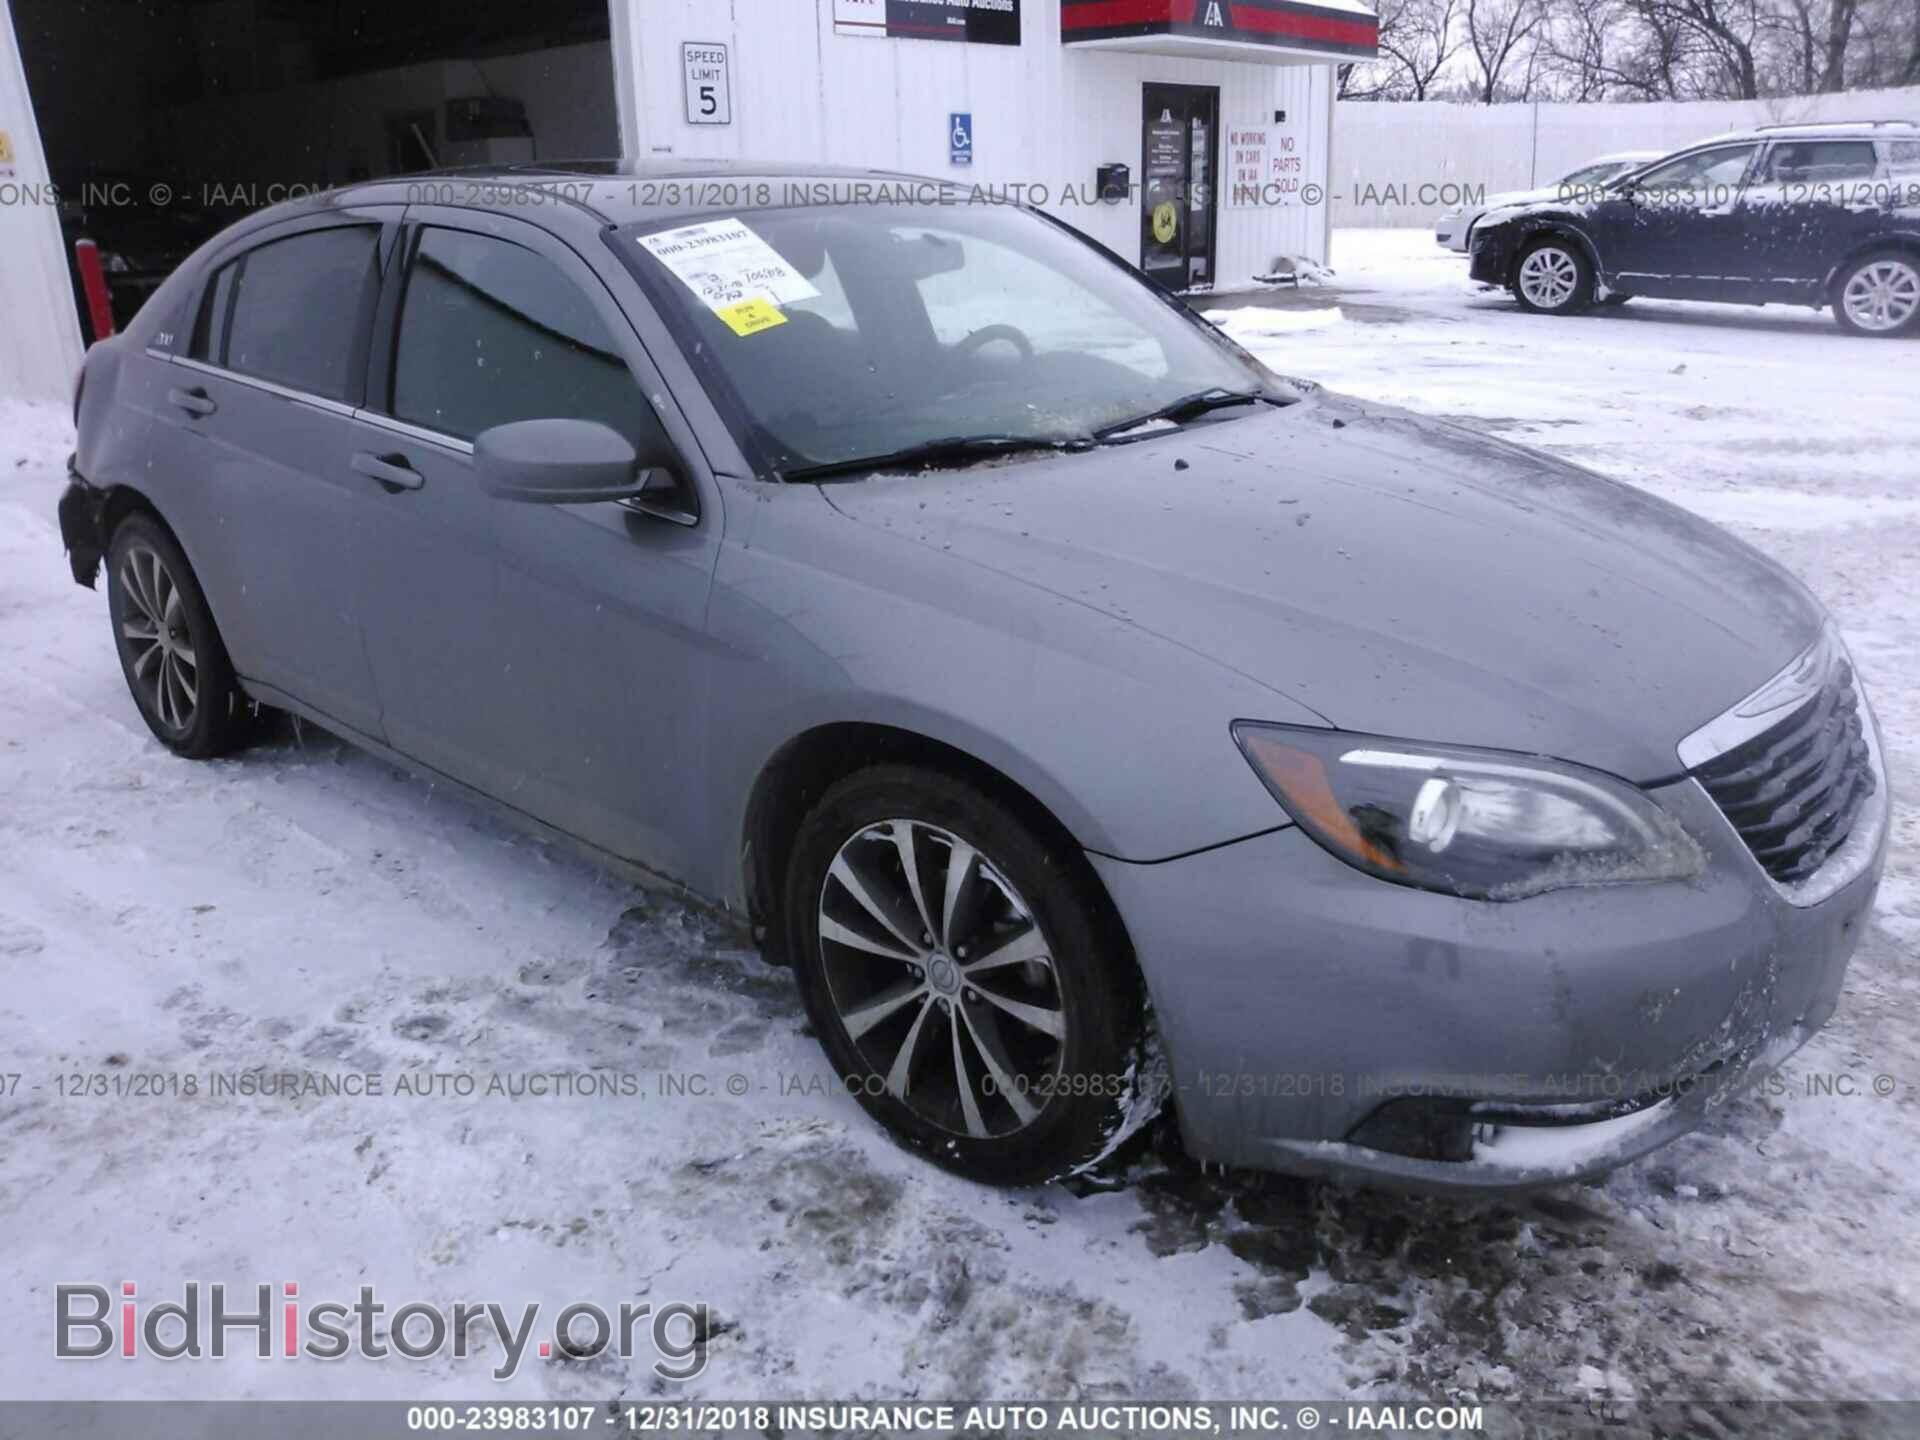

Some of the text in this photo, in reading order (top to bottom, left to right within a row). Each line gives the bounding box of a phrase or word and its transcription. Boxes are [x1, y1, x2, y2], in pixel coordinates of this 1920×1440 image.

[972, 0, 1014, 11] Auctions
[687, 51, 724, 63] SPEED
[691, 68, 720, 81] LIMIT
[700, 86, 717, 115] 5
[1280, 136, 1295, 152] NO
[1272, 156, 1301, 172] PARTS
[1273, 178, 1299, 194] SOLD
